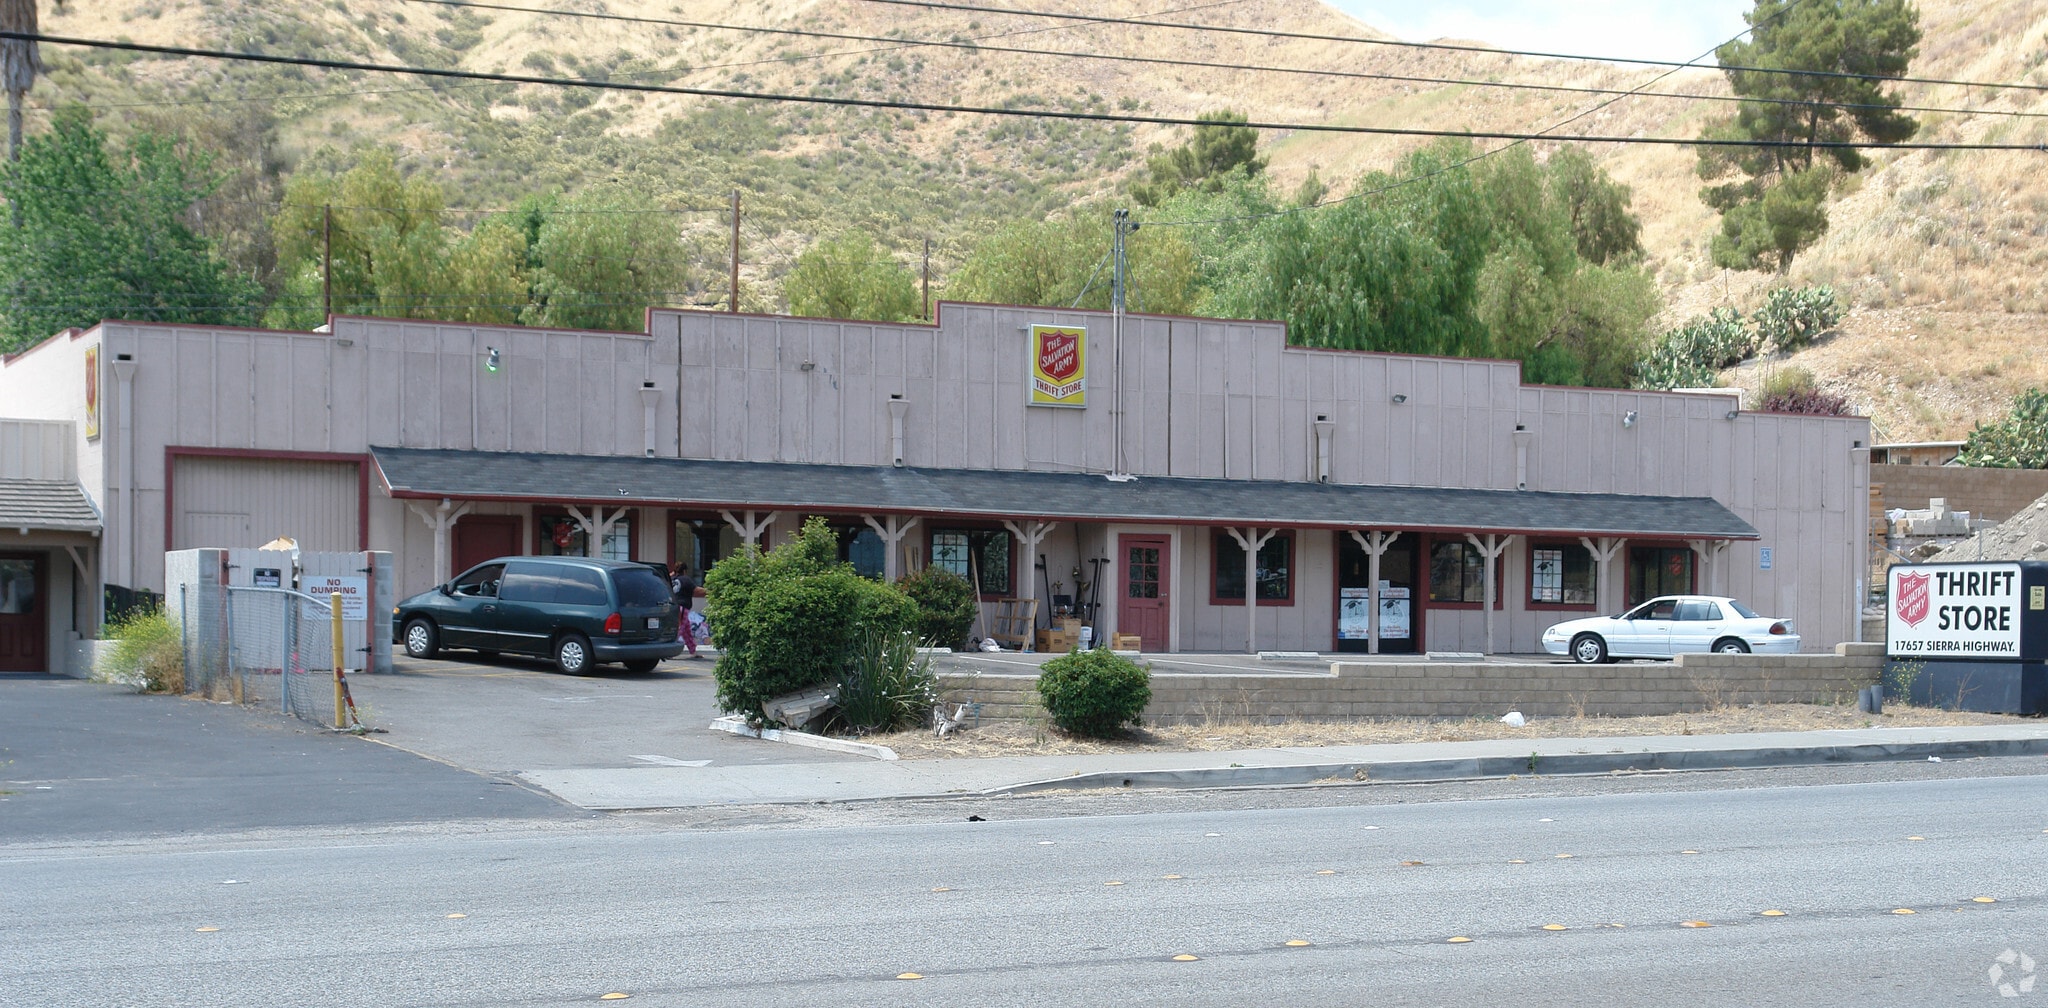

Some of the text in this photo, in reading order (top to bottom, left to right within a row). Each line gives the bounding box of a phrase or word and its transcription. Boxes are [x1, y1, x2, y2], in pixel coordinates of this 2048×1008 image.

[1042, 339, 1075, 367] SALVATION
[1047, 336, 1061, 352] THE
[1053, 353, 1074, 374] ARMY
[1036, 379, 1082, 396] THRIFT STORE
[310, 586, 357, 594] DUMPING
[326, 578, 341, 586] NO
[1903, 577, 1916, 594] THE
[1936, 571, 2015, 596] THRIFT
[1898, 580, 1927, 612] SALVATION
[1907, 595, 1926, 620] ARMY
[1938, 605, 2011, 631] STORE
[1895, 640, 2015, 652] 17657 SIERRA HIGHWAY.
